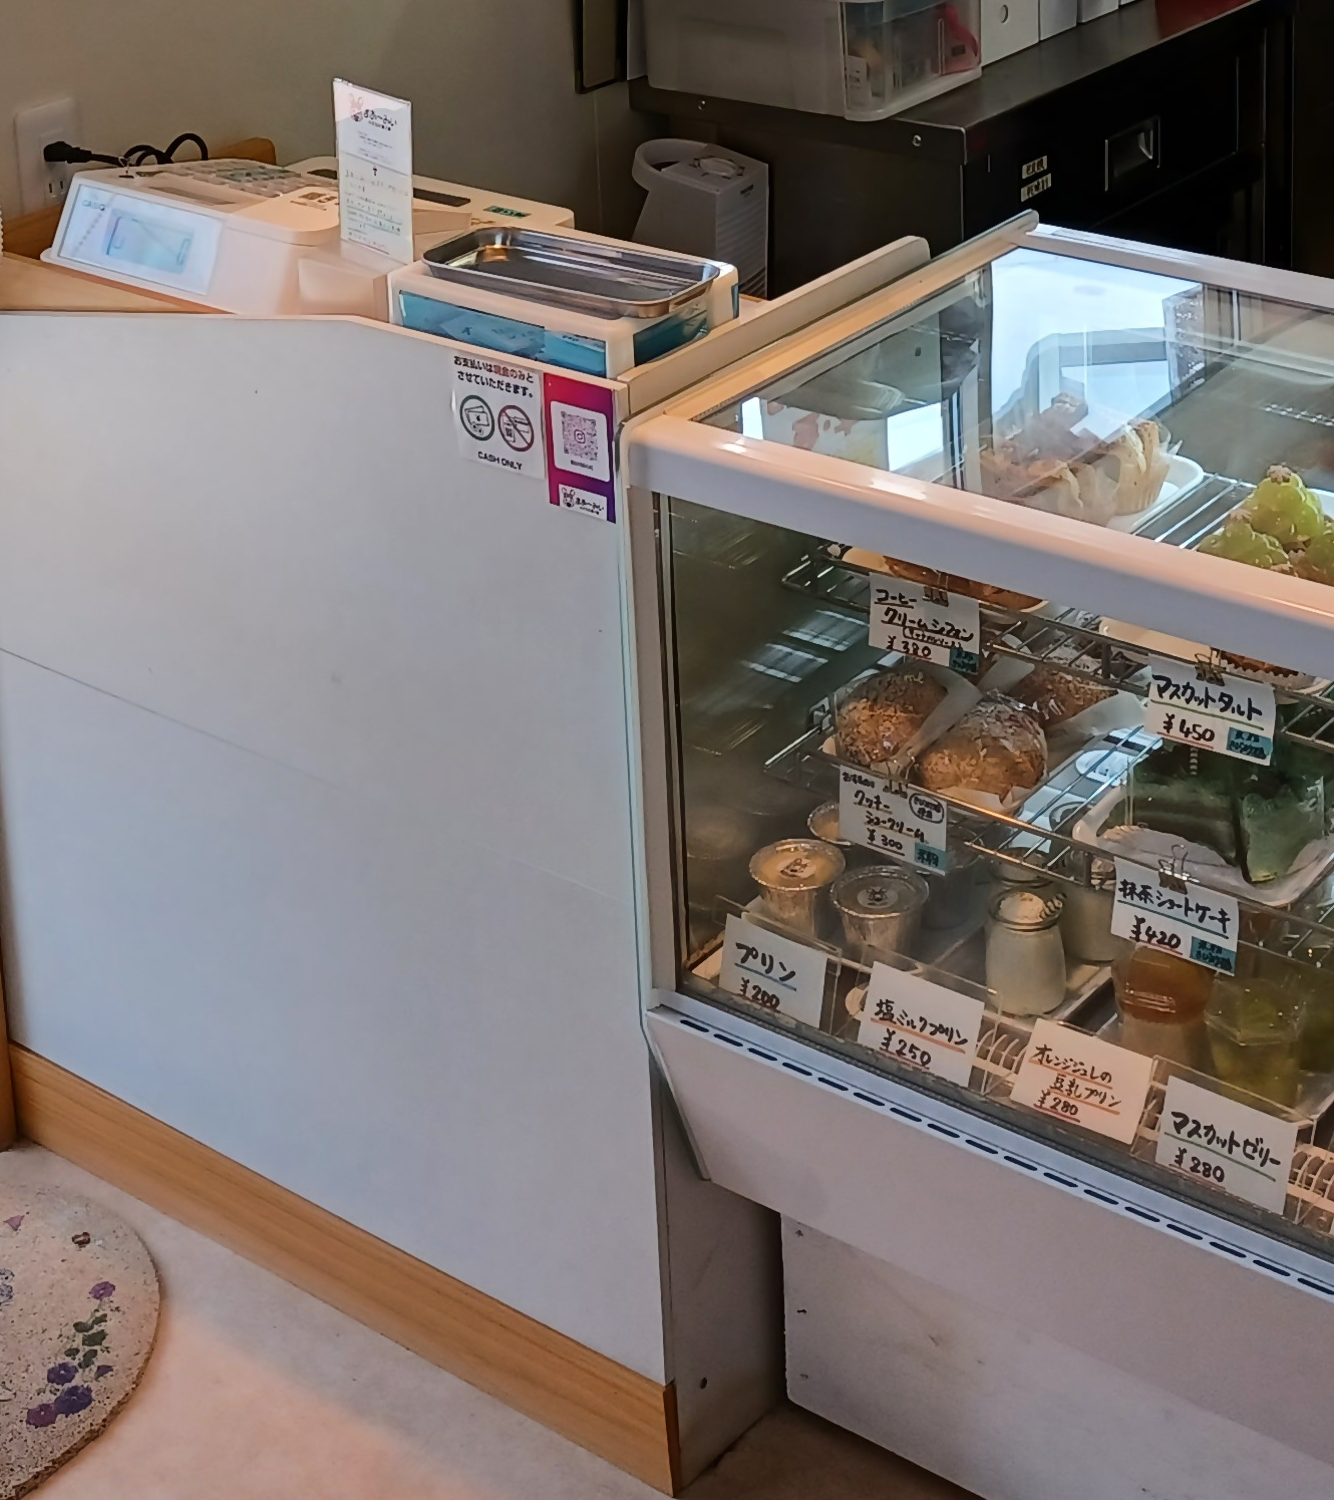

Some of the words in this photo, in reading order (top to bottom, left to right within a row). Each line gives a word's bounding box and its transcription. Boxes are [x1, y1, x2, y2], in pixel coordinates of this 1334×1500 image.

[453, 355, 535, 384] お支払いは現金のみと
[456, 370, 535, 399] させていただきます。
[477, 450, 501, 465] CASH
[501, 456, 523, 472] ONLY
[875, 588, 918, 605] コーヒー
[1152, 673, 1264, 722] マスカットタルト
[1162, 712, 1216, 743] ¥450
[854, 789, 891, 812] クッキー
[864, 810, 926, 843] シュークリーム
[866, 827, 904, 851] ¥300
[1118, 878, 1232, 934] 抹茶ショートケーキ
[1129, 914, 1182, 950] ¥420
[735, 941, 797, 983] プリン
[738, 976, 781, 1012] ¥200
[873, 997, 970, 1047] 塩ミルクプリン
[879, 1027, 933, 1068] ¥250
[1033, 1090, 1080, 1118] ¥280
[1049, 1074, 1123, 1110] 豆乳プリン
[1169, 1109, 1282, 1169] マスカットゼリー
[1173, 1146, 1227, 1185] ¥280
